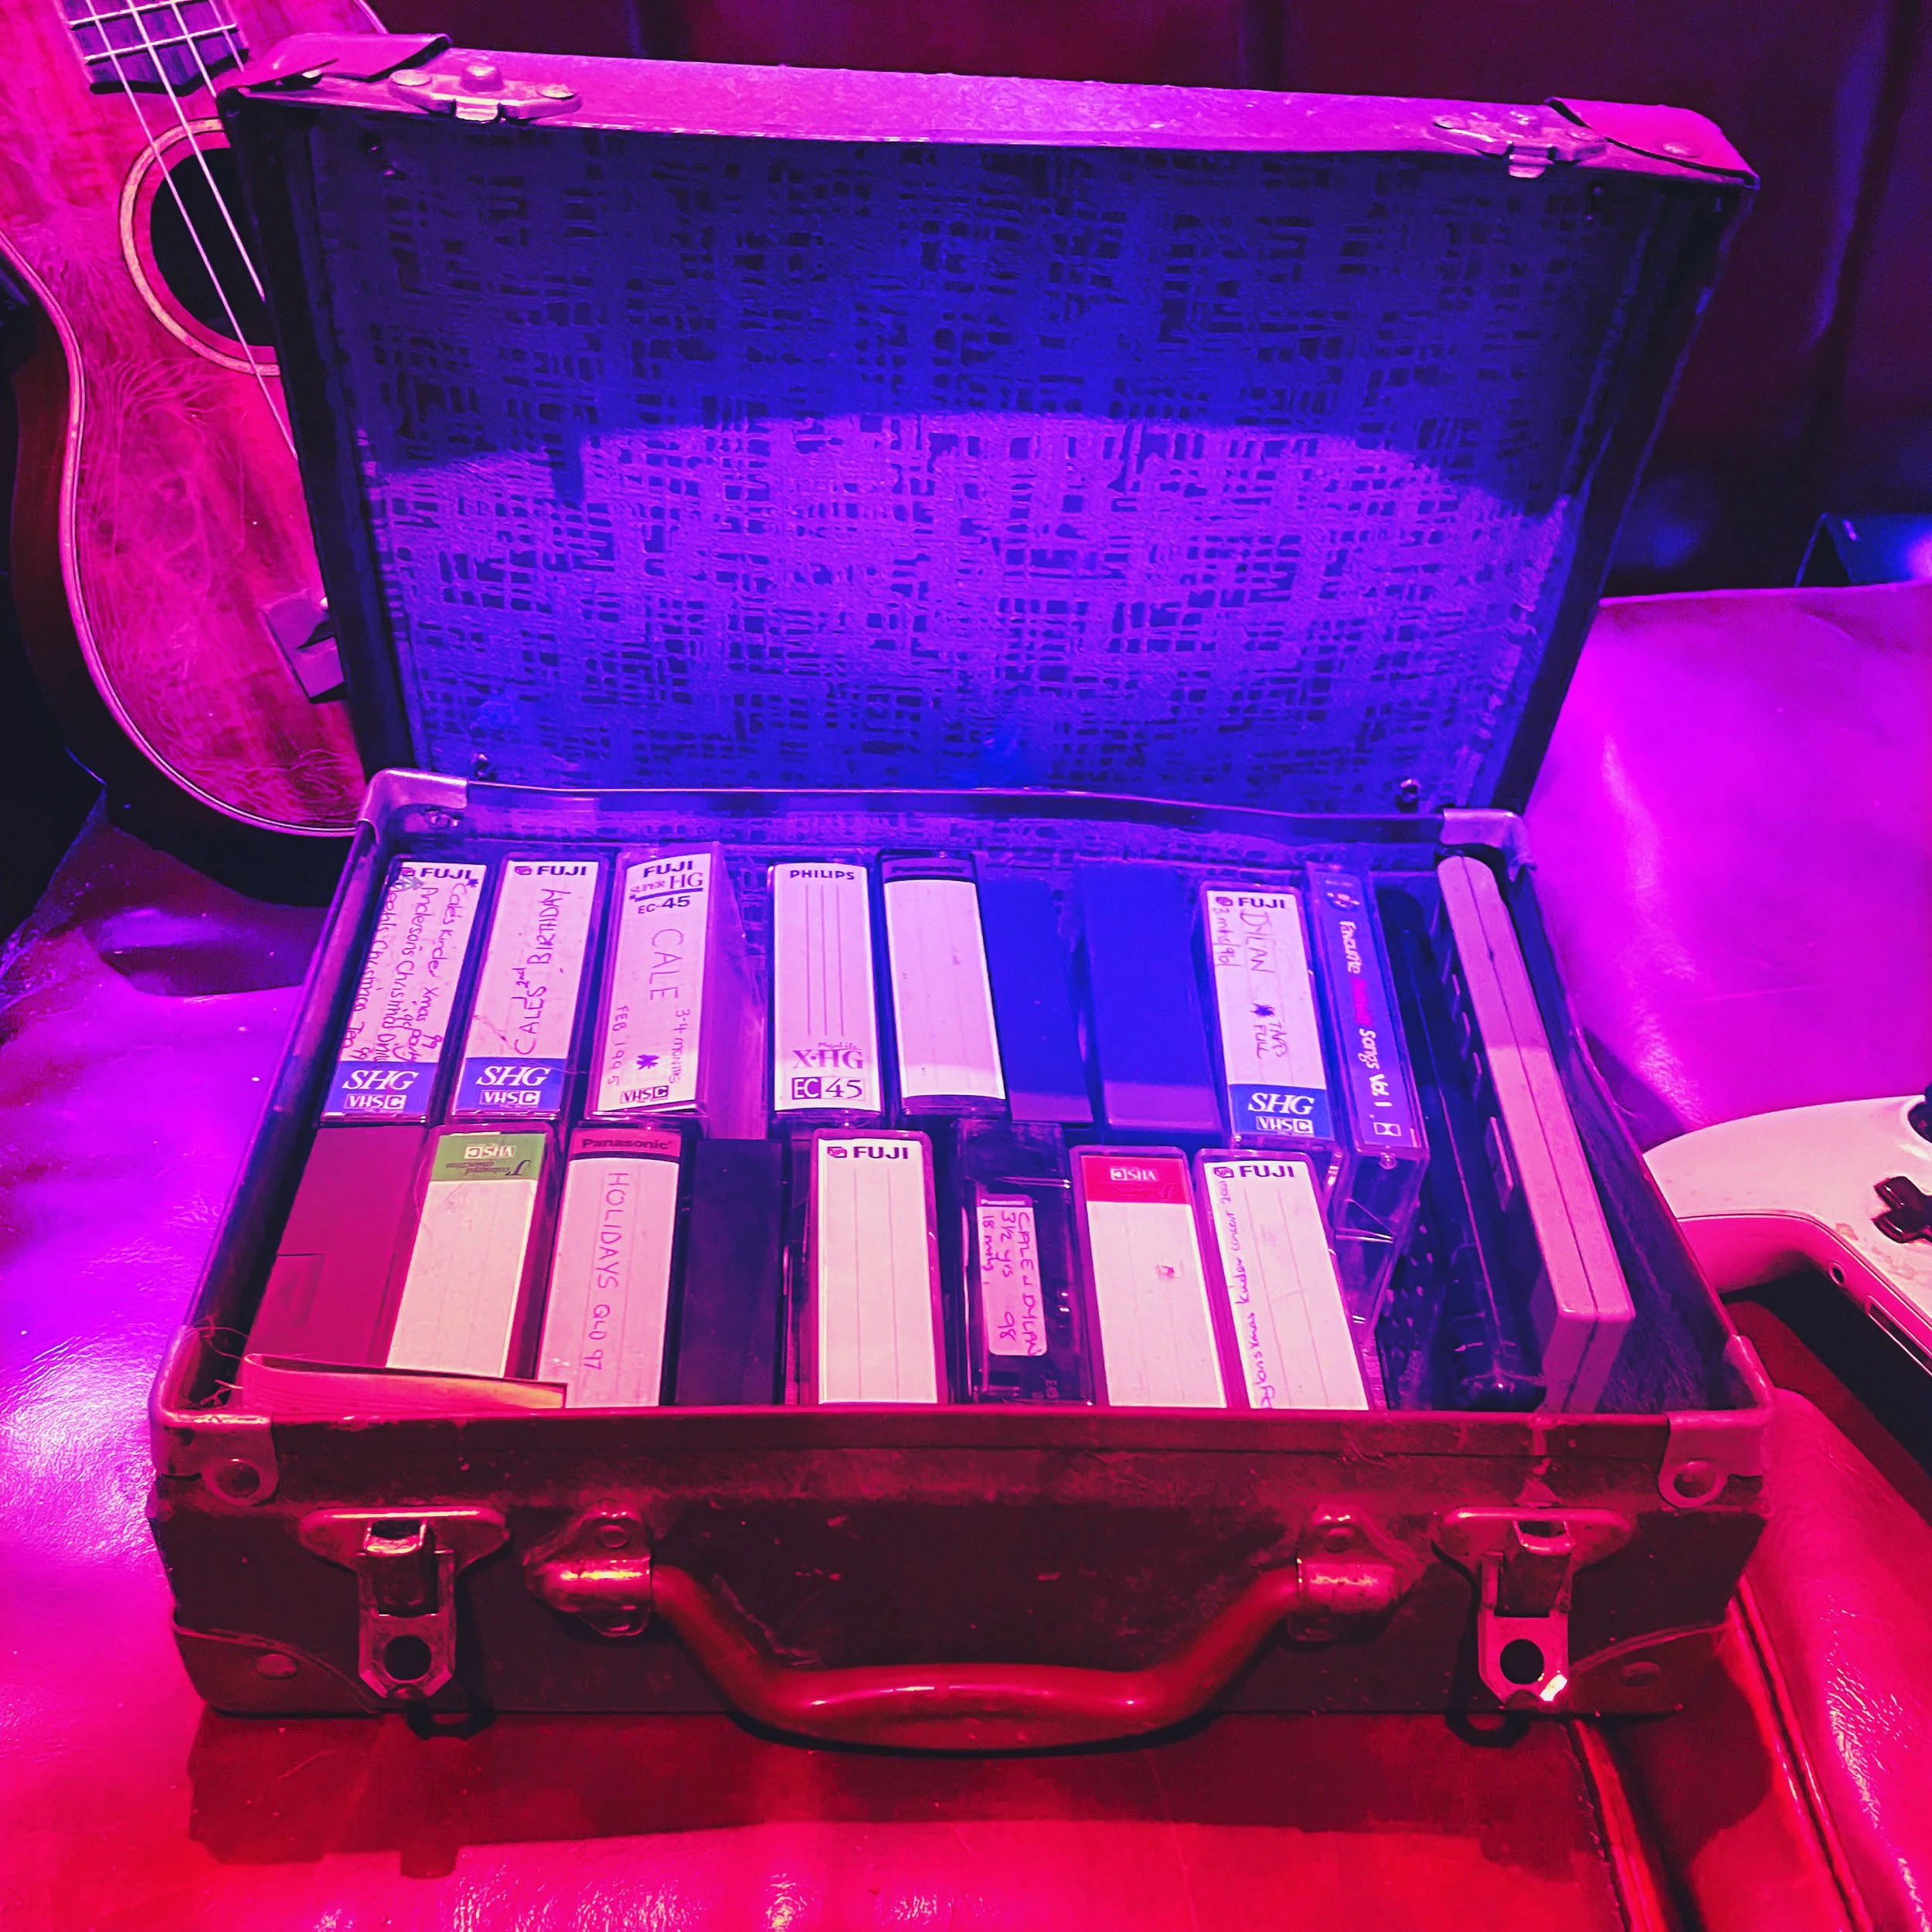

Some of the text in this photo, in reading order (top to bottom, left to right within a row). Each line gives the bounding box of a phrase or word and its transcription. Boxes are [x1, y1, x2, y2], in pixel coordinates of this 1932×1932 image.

[420, 867, 474, 879] FUJI
[536, 866, 587, 876] FUJI
[643, 860, 693, 878] FUJI
[790, 869, 855, 880] PHILIPS
[669, 872, 703, 889] HG
[638, 896, 691, 914] EC-45
[1238, 896, 1286, 909] FUJI
[526, 889, 571, 964] BIRTHDAY
[1240, 909, 1275, 974] DYLAN
[649, 928, 684, 1000] CALE
[416, 987, 439, 1021] Xmas
[673, 1009, 691, 1034] 3-4
[607, 1005, 629, 1087] FEB 1995
[1253, 1024, 1269, 1060] FULL
[1358, 1028, 1380, 1070] Songs
[342, 1070, 420, 1090] SHG
[476, 1066, 551, 1086] SHG
[793, 1077, 863, 1099] EC 45
[1247, 1092, 1315, 1114] SHG
[581, 1138, 668, 1150] Panasonic
[853, 1146, 909, 1159] FUJI
[1239, 1165, 1295, 1178] FUJI
[981, 1215, 995, 1229] 18
[1018, 1211, 1035, 1271] CALE
[583, 1172, 630, 1371] HOLIDAYS QLD 97
[995, 1249, 1014, 1278] yrs
[997, 1311, 1017, 1342] 98
